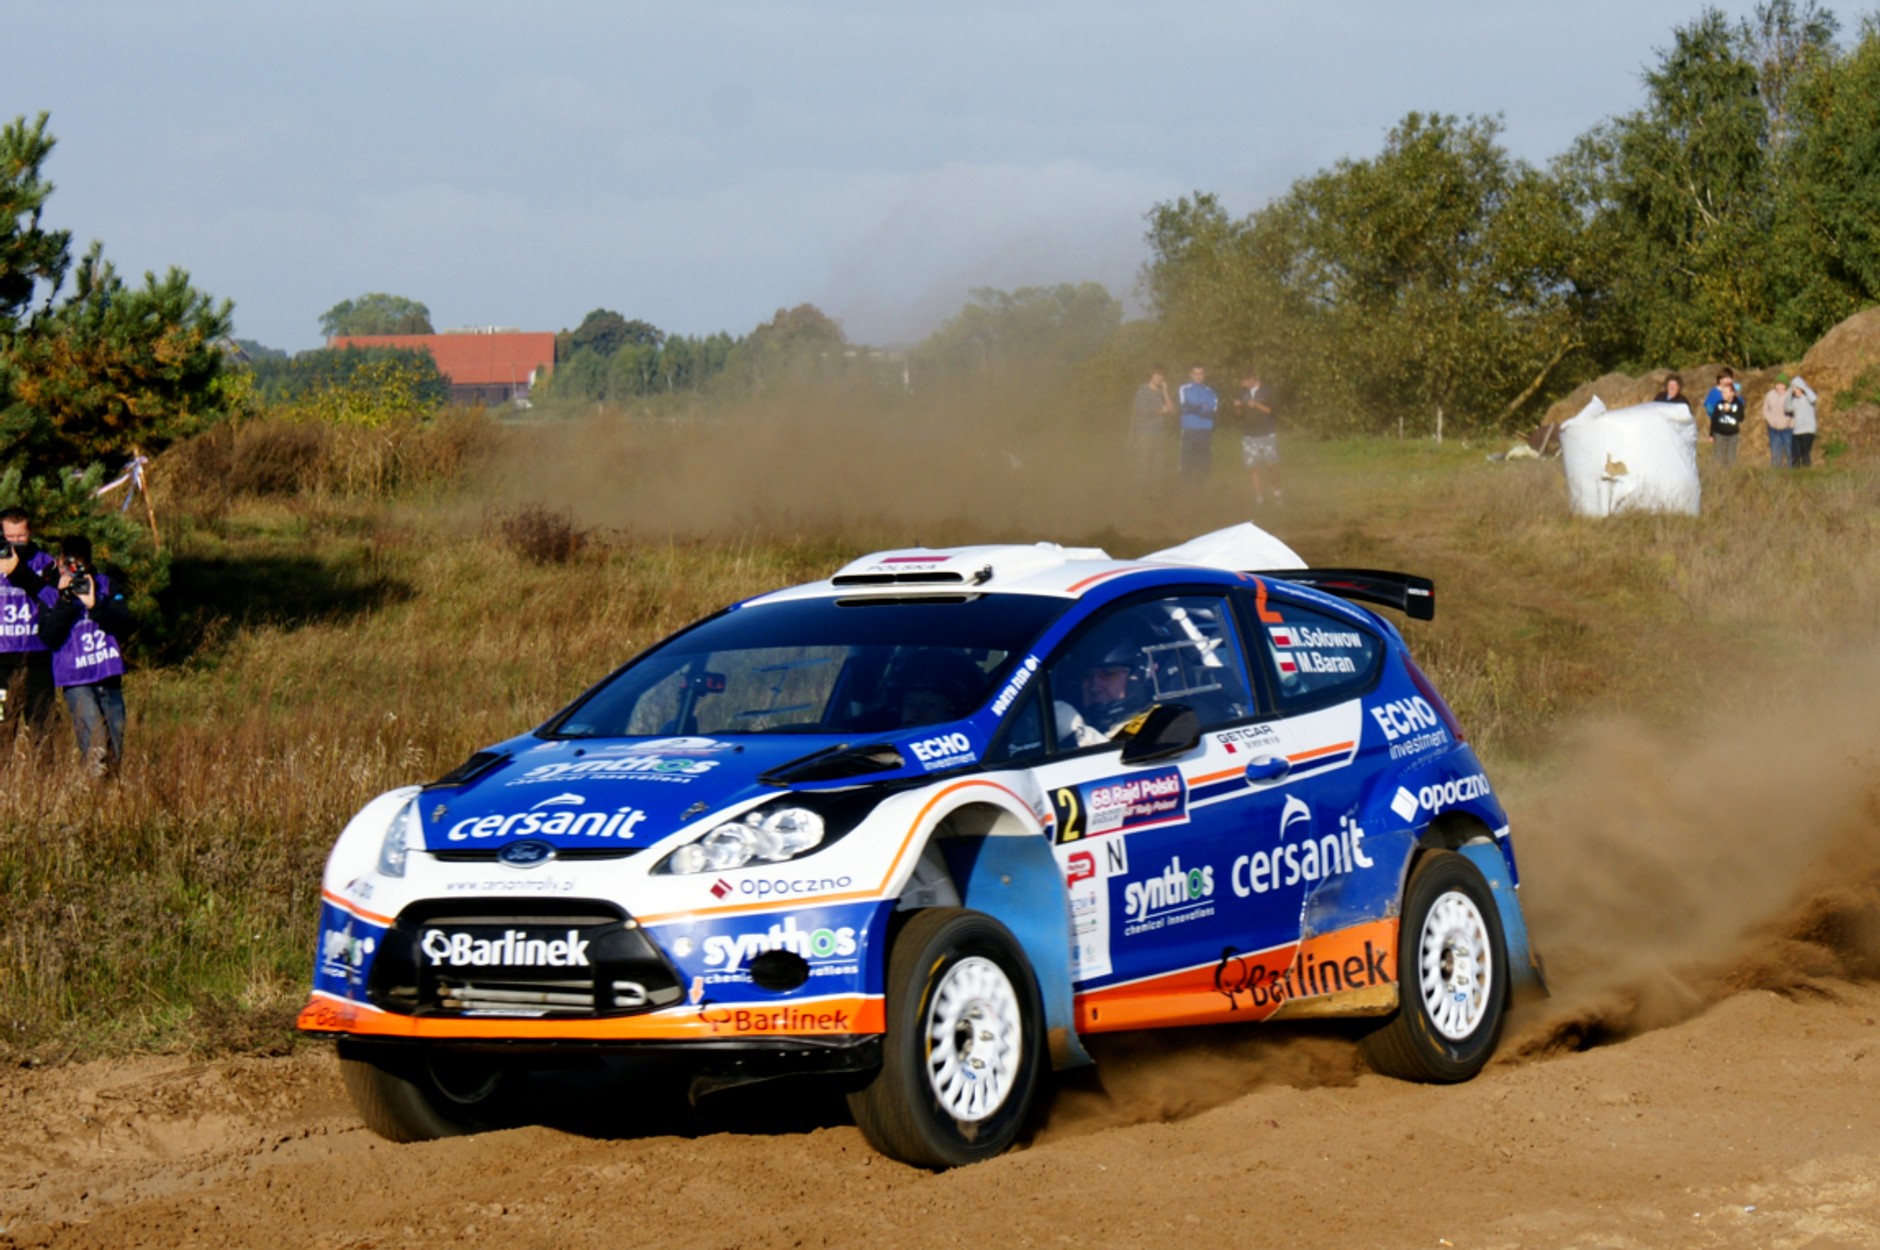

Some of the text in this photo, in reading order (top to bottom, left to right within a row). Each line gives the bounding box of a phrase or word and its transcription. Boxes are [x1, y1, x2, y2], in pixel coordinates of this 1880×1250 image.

[3, 603, 32, 623] 34
[81, 629, 106, 652] 32
[75, 647, 120, 669] MEDIA
[1299, 651, 1355, 673] M.Baran
[1217, 725, 1273, 743] GETCAR
[1370, 696, 1438, 741] ECHO
[908, 732, 970, 762] ECHO
[1389, 728, 1448, 760] investment
[524, 755, 720, 778] synthos
[1091, 788, 1111, 809] 68
[1141, 774, 1179, 799] Polski
[1419, 773, 1490, 815] opoczno
[448, 807, 647, 841] cersanit
[1057, 787, 1080, 841] 2
[1106, 839, 1123, 873] N
[1232, 816, 1374, 898] cersanit
[740, 876, 852, 898] opoczno
[1124, 856, 1214, 922] synthos
[450, 931, 590, 966] Barlinek
[703, 917, 857, 973] synthos
[735, 1008, 850, 1031] Barlinek
